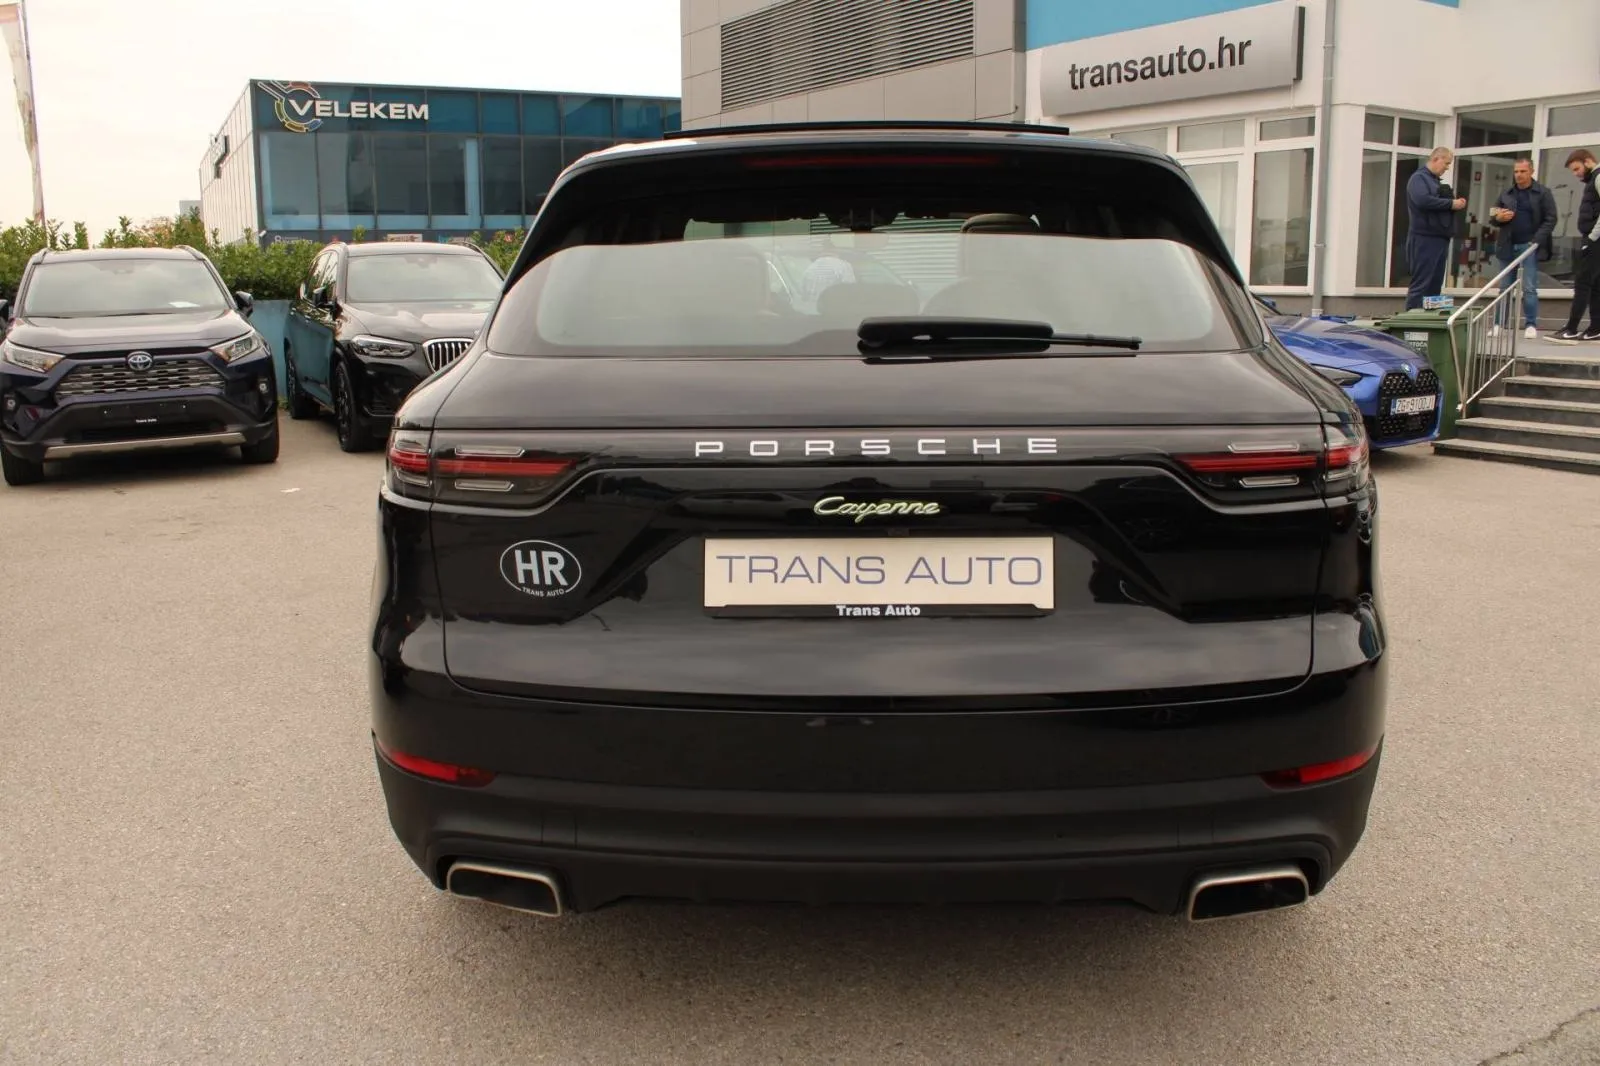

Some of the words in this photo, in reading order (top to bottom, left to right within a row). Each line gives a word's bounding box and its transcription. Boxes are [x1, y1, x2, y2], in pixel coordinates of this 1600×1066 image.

[1068, 36, 1252, 90] transauto.hr
[289, 100, 429, 121] VELEKEM
[695, 438, 1058, 456] PORSCHE
[813, 496, 940, 523] Cayenne
[514, 549, 568, 586] HR
[716, 555, 886, 585] TRANS
[904, 556, 1043, 586] AUTO
[522, 586, 544, 597] TRANS
[546, 588, 565, 597] AUTO
[836, 604, 880, 616] Trans
[885, 604, 921, 616] Auto
